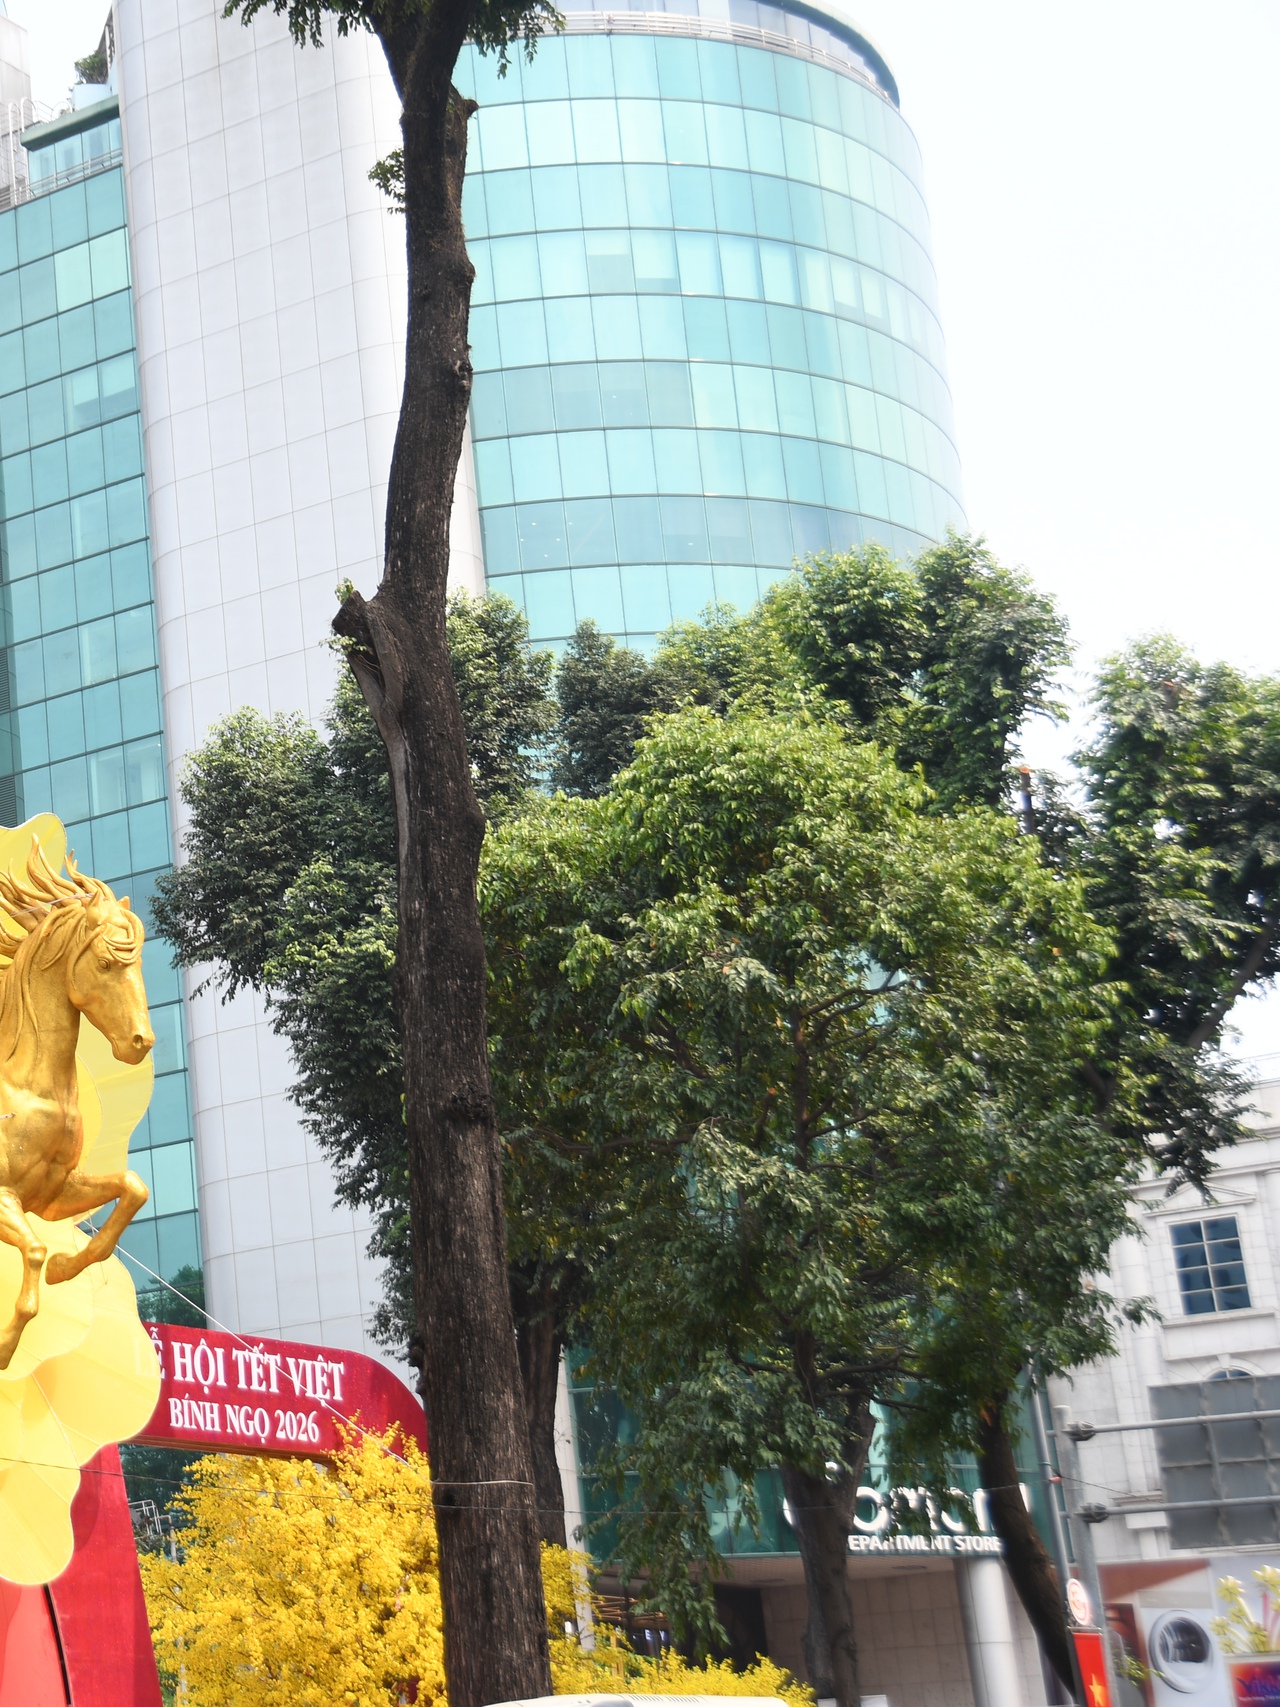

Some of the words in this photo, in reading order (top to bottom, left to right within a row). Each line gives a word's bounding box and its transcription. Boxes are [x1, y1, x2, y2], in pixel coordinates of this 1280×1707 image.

[170, 1337, 228, 1394] HỘI
[231, 1342, 281, 1393] TẾT
[285, 1354, 345, 1407] VIỆT
[168, 1393, 222, 1432] BÍNH
[224, 1403, 271, 1444] NGỌ
[274, 1409, 320, 1443] 2026
[847, 1534, 952, 1551] EPATMENT
[953, 1535, 1002, 1551] STORE
